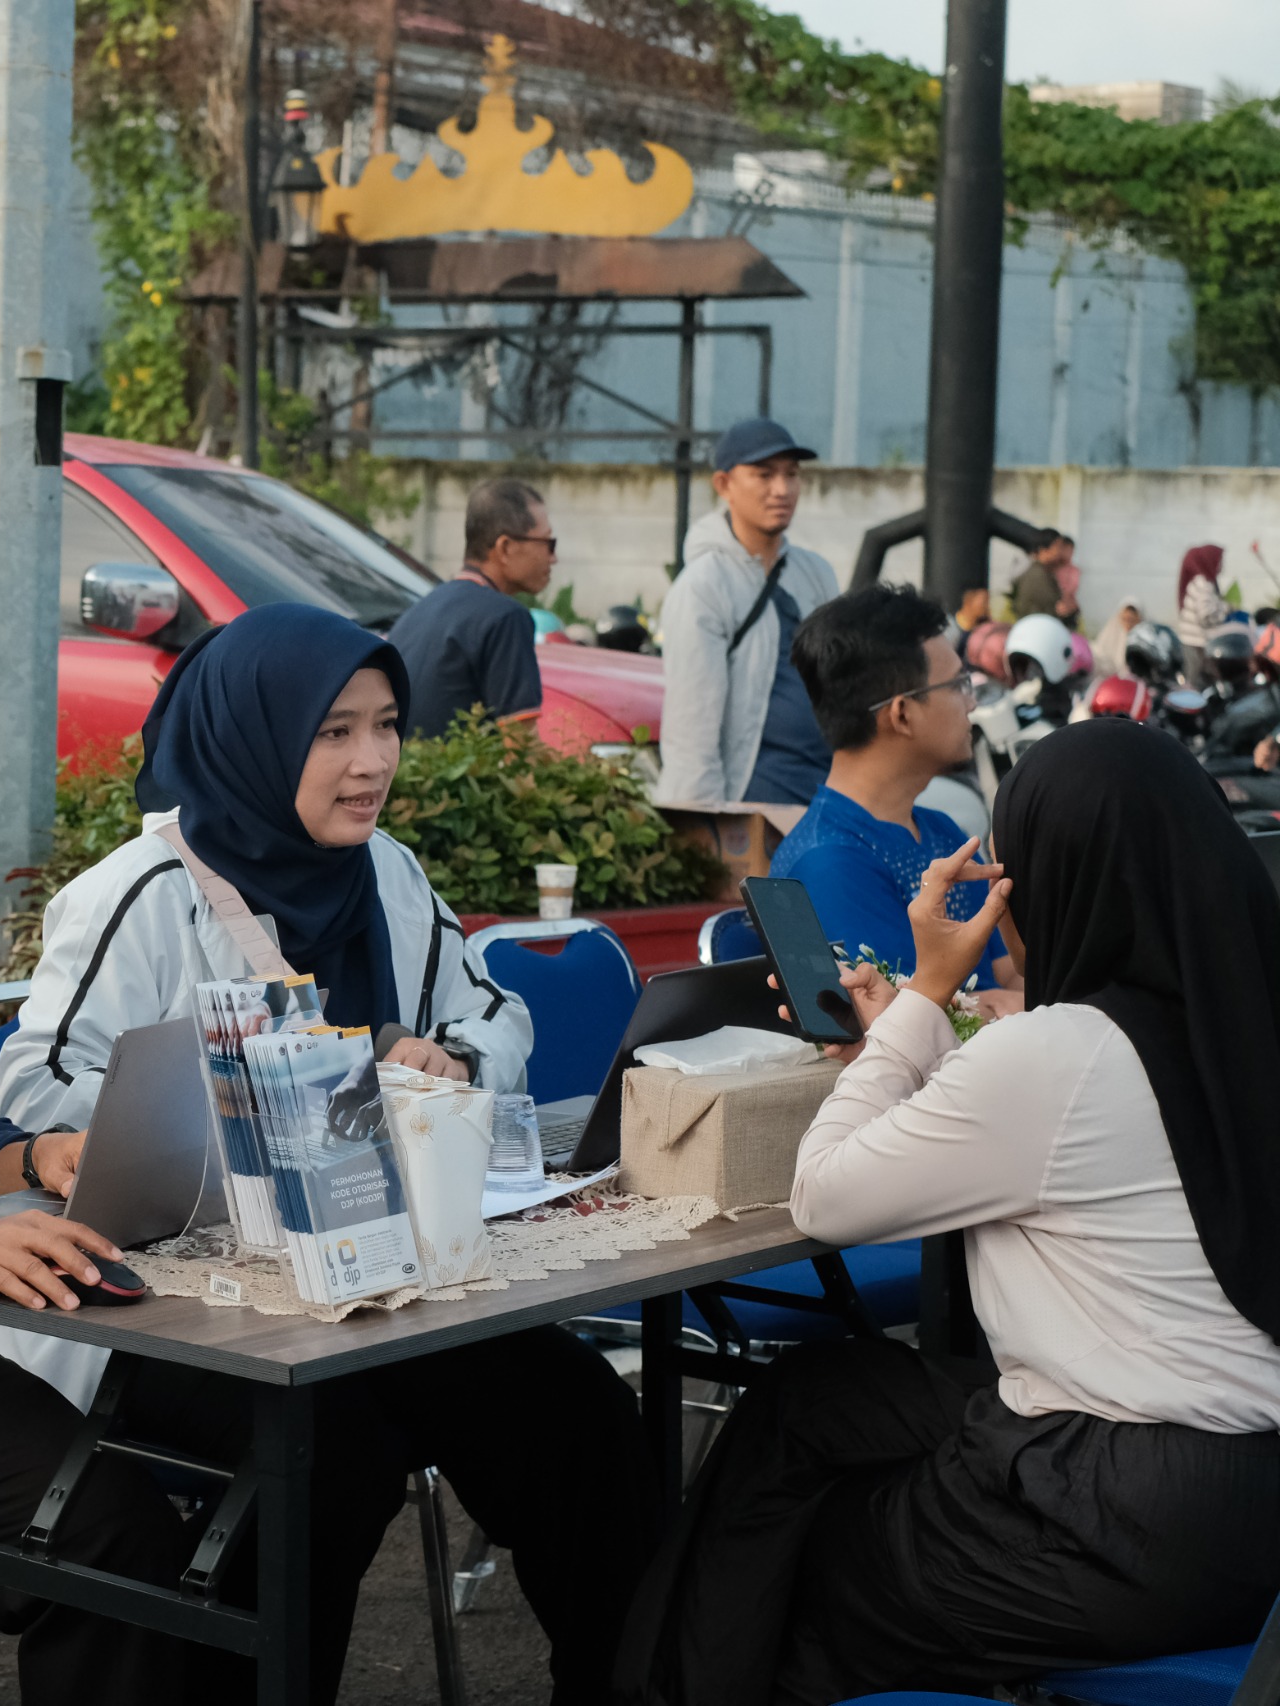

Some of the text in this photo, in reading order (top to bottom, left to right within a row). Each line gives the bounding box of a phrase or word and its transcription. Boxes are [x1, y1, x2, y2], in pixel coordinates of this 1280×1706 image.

[330, 1168, 384, 1187] PERMOHONAN
[330, 1179, 390, 1200] KODE OTORISASI
[340, 1191, 385, 1209] DJP (KODJP)
[343, 1266, 361, 1286] djp
